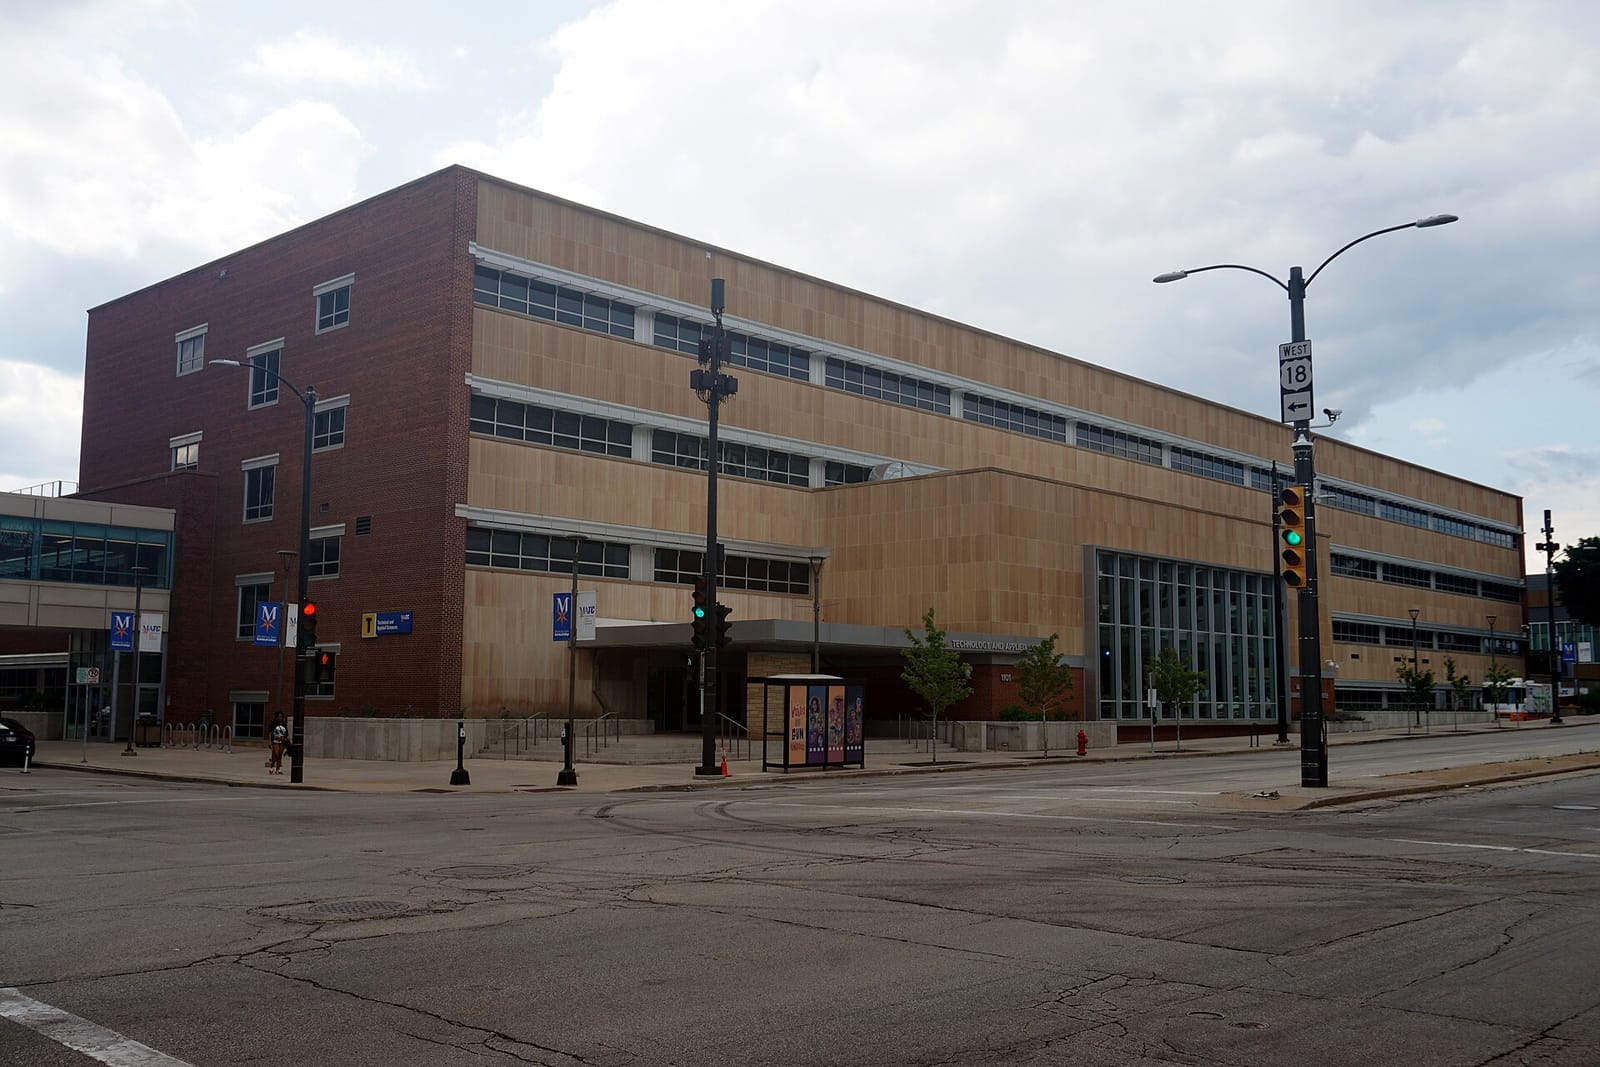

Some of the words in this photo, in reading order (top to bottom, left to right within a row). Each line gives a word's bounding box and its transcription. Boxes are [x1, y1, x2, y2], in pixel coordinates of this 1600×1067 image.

[1283, 344, 1308, 357] WEST
[1287, 365, 1306, 384] 18
[556, 597, 570, 613] M
[262, 606, 278, 620] M
[115, 615, 130, 628] M
[952, 639, 990, 649] TECHNOLOGY
[992, 641, 1004, 650] AND
